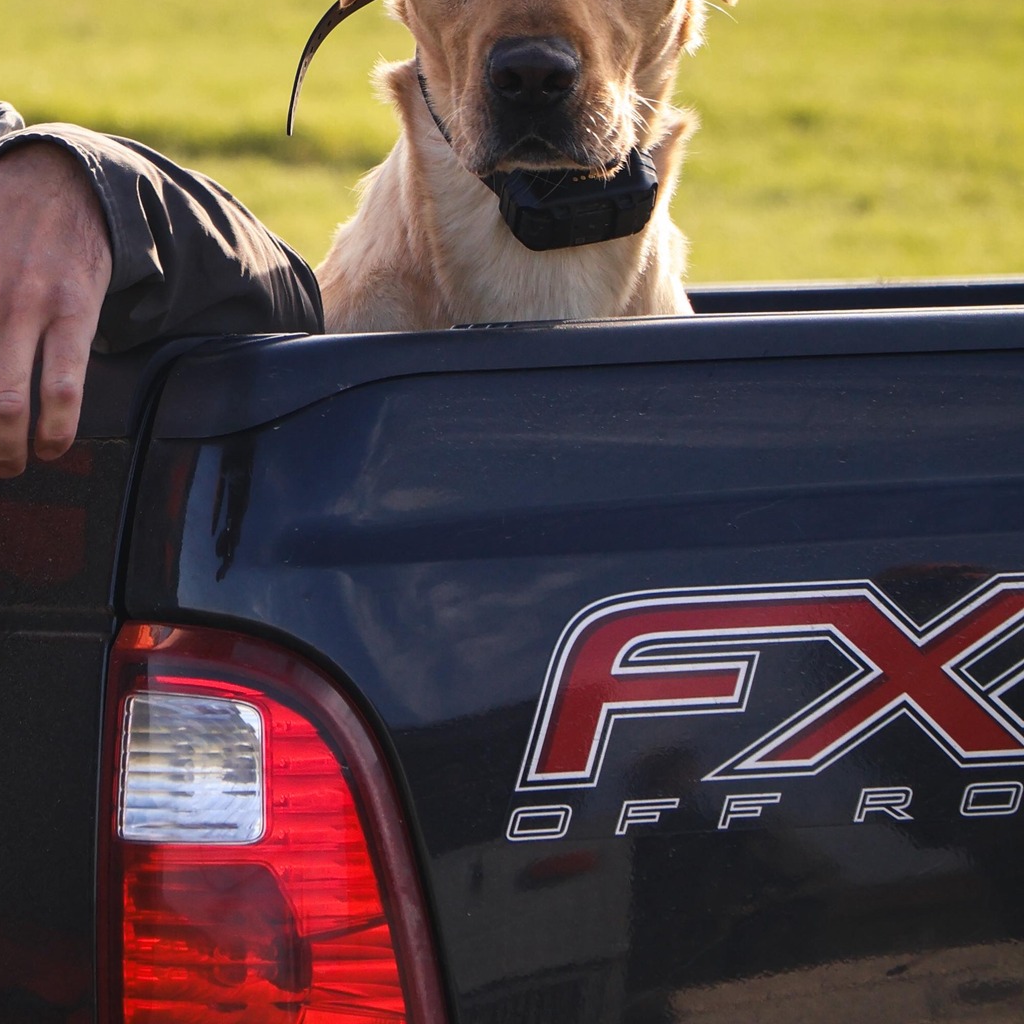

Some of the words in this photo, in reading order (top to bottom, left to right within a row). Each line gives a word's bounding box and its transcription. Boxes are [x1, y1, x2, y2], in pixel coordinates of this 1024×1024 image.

[515, 571, 1024, 793] FX
[505, 792, 783, 842] OFF
[853, 780, 1023, 823] RO
